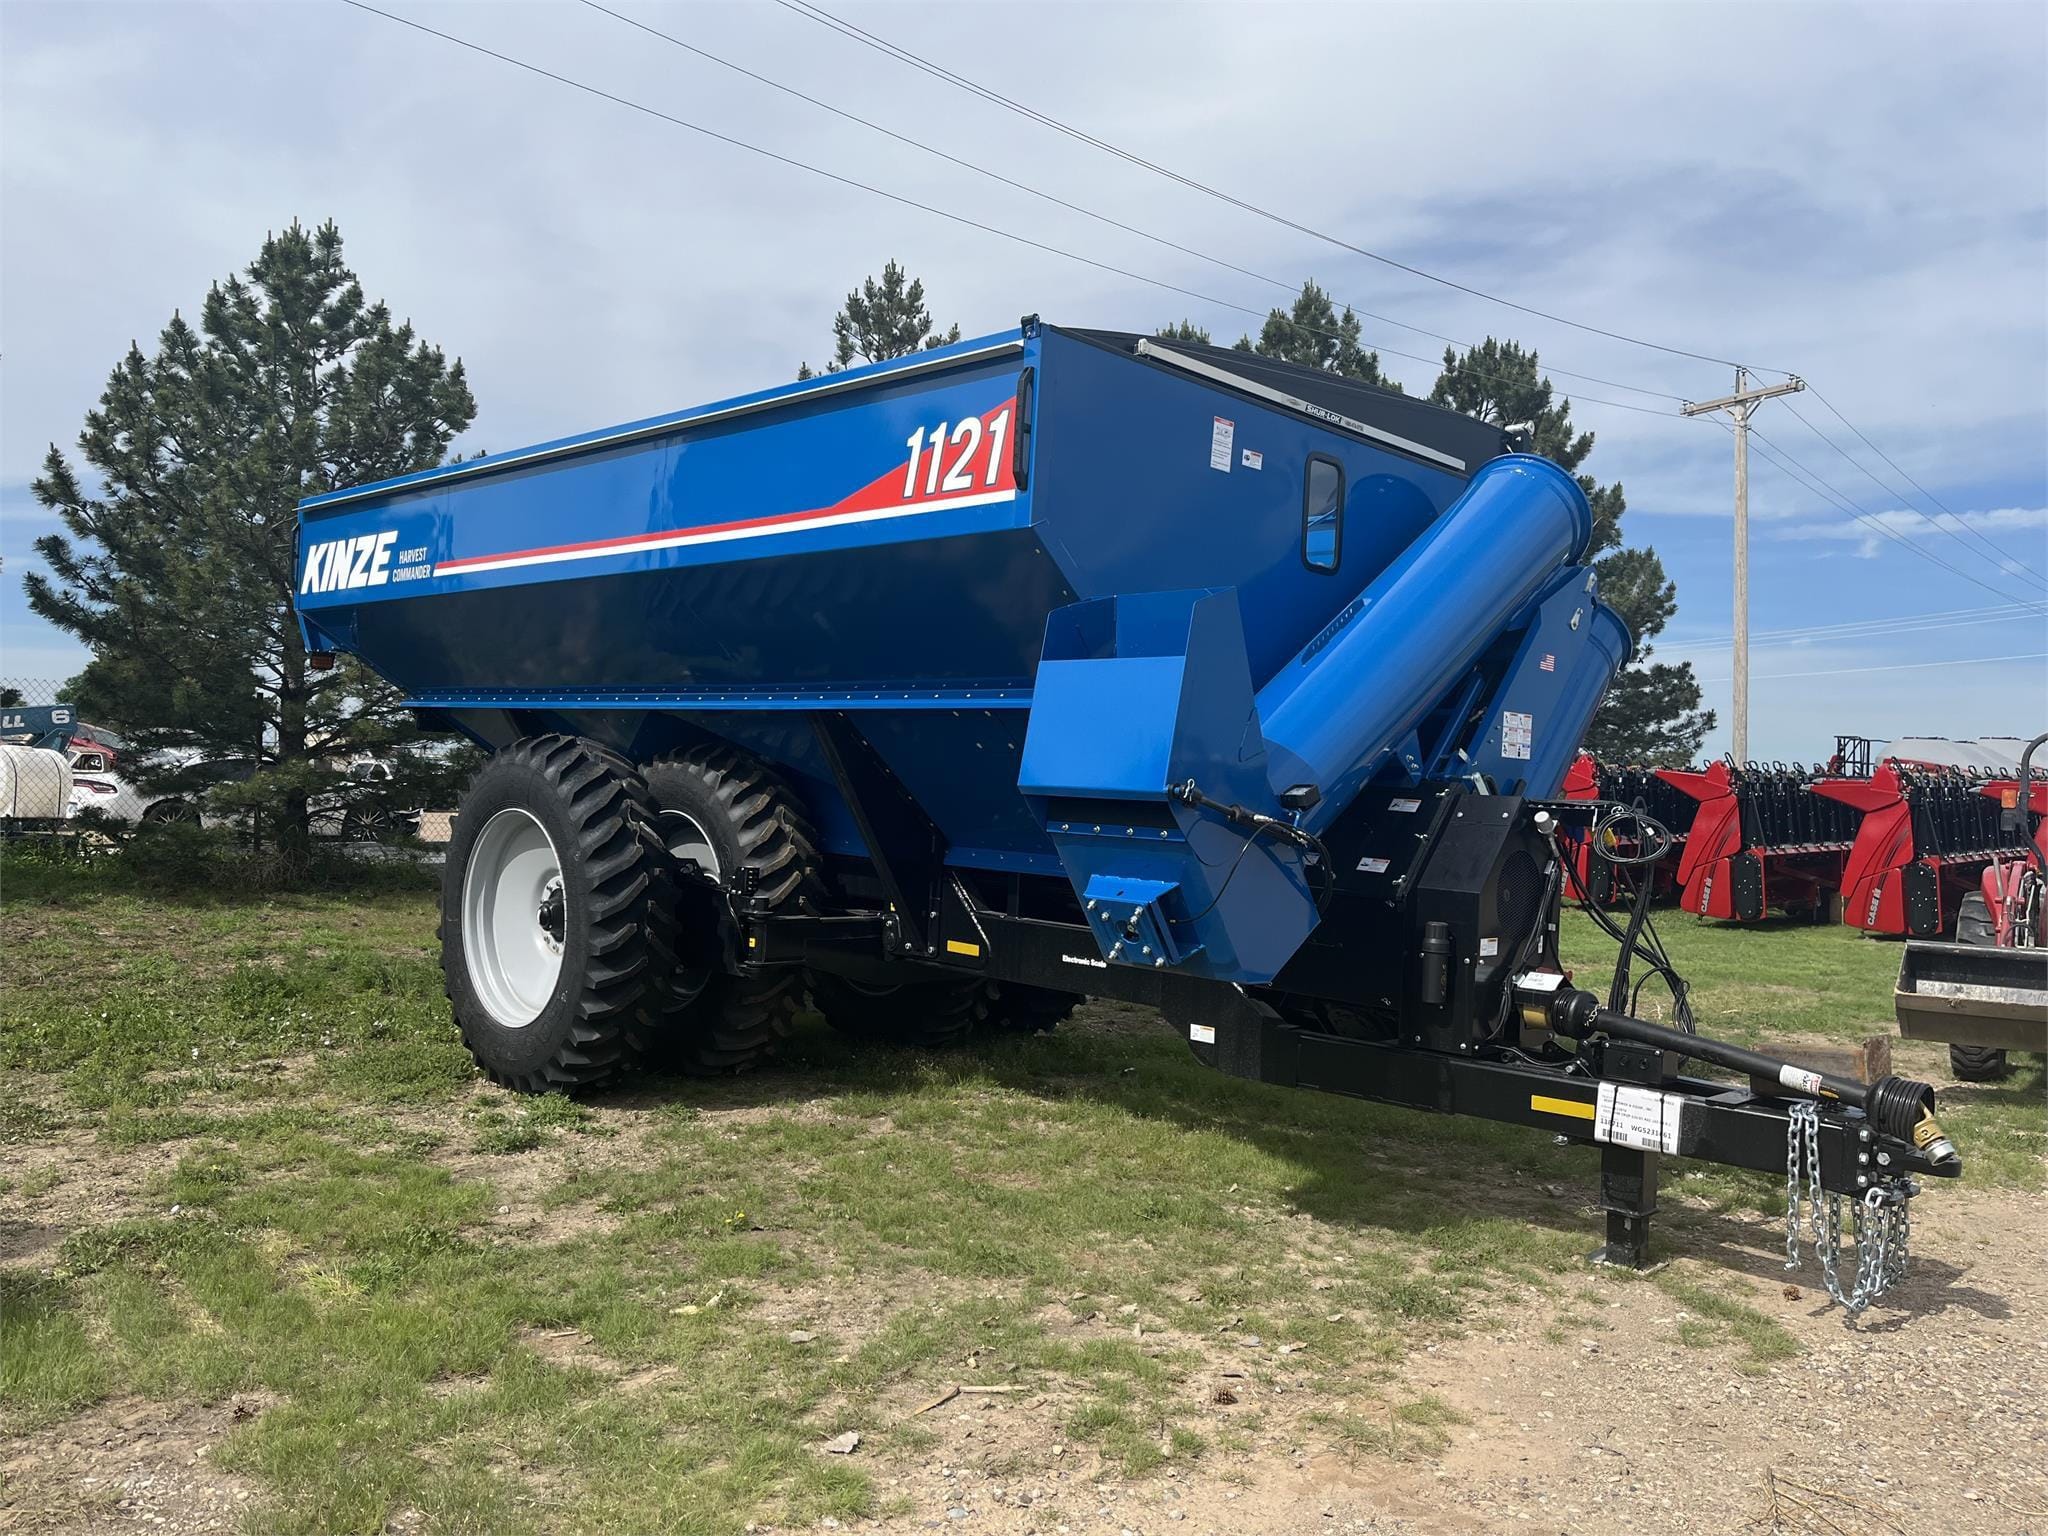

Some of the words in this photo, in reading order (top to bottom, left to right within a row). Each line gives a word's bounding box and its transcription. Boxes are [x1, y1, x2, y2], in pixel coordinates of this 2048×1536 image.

[1306, 404, 1341, 423] SHUR-LOK
[903, 409, 1010, 498] 1121
[300, 530, 398, 595] KINZE
[399, 547, 427, 564] HARVEST
[392, 565, 431, 583] COMMANDER
[51, 709, 70, 724] 6
[1701, 886, 1711, 912] CASE
[1867, 897, 1880, 926] CASE
[1062, 954, 1090, 967] Electronic
[1631, 1124, 1672, 1139] WG523161
